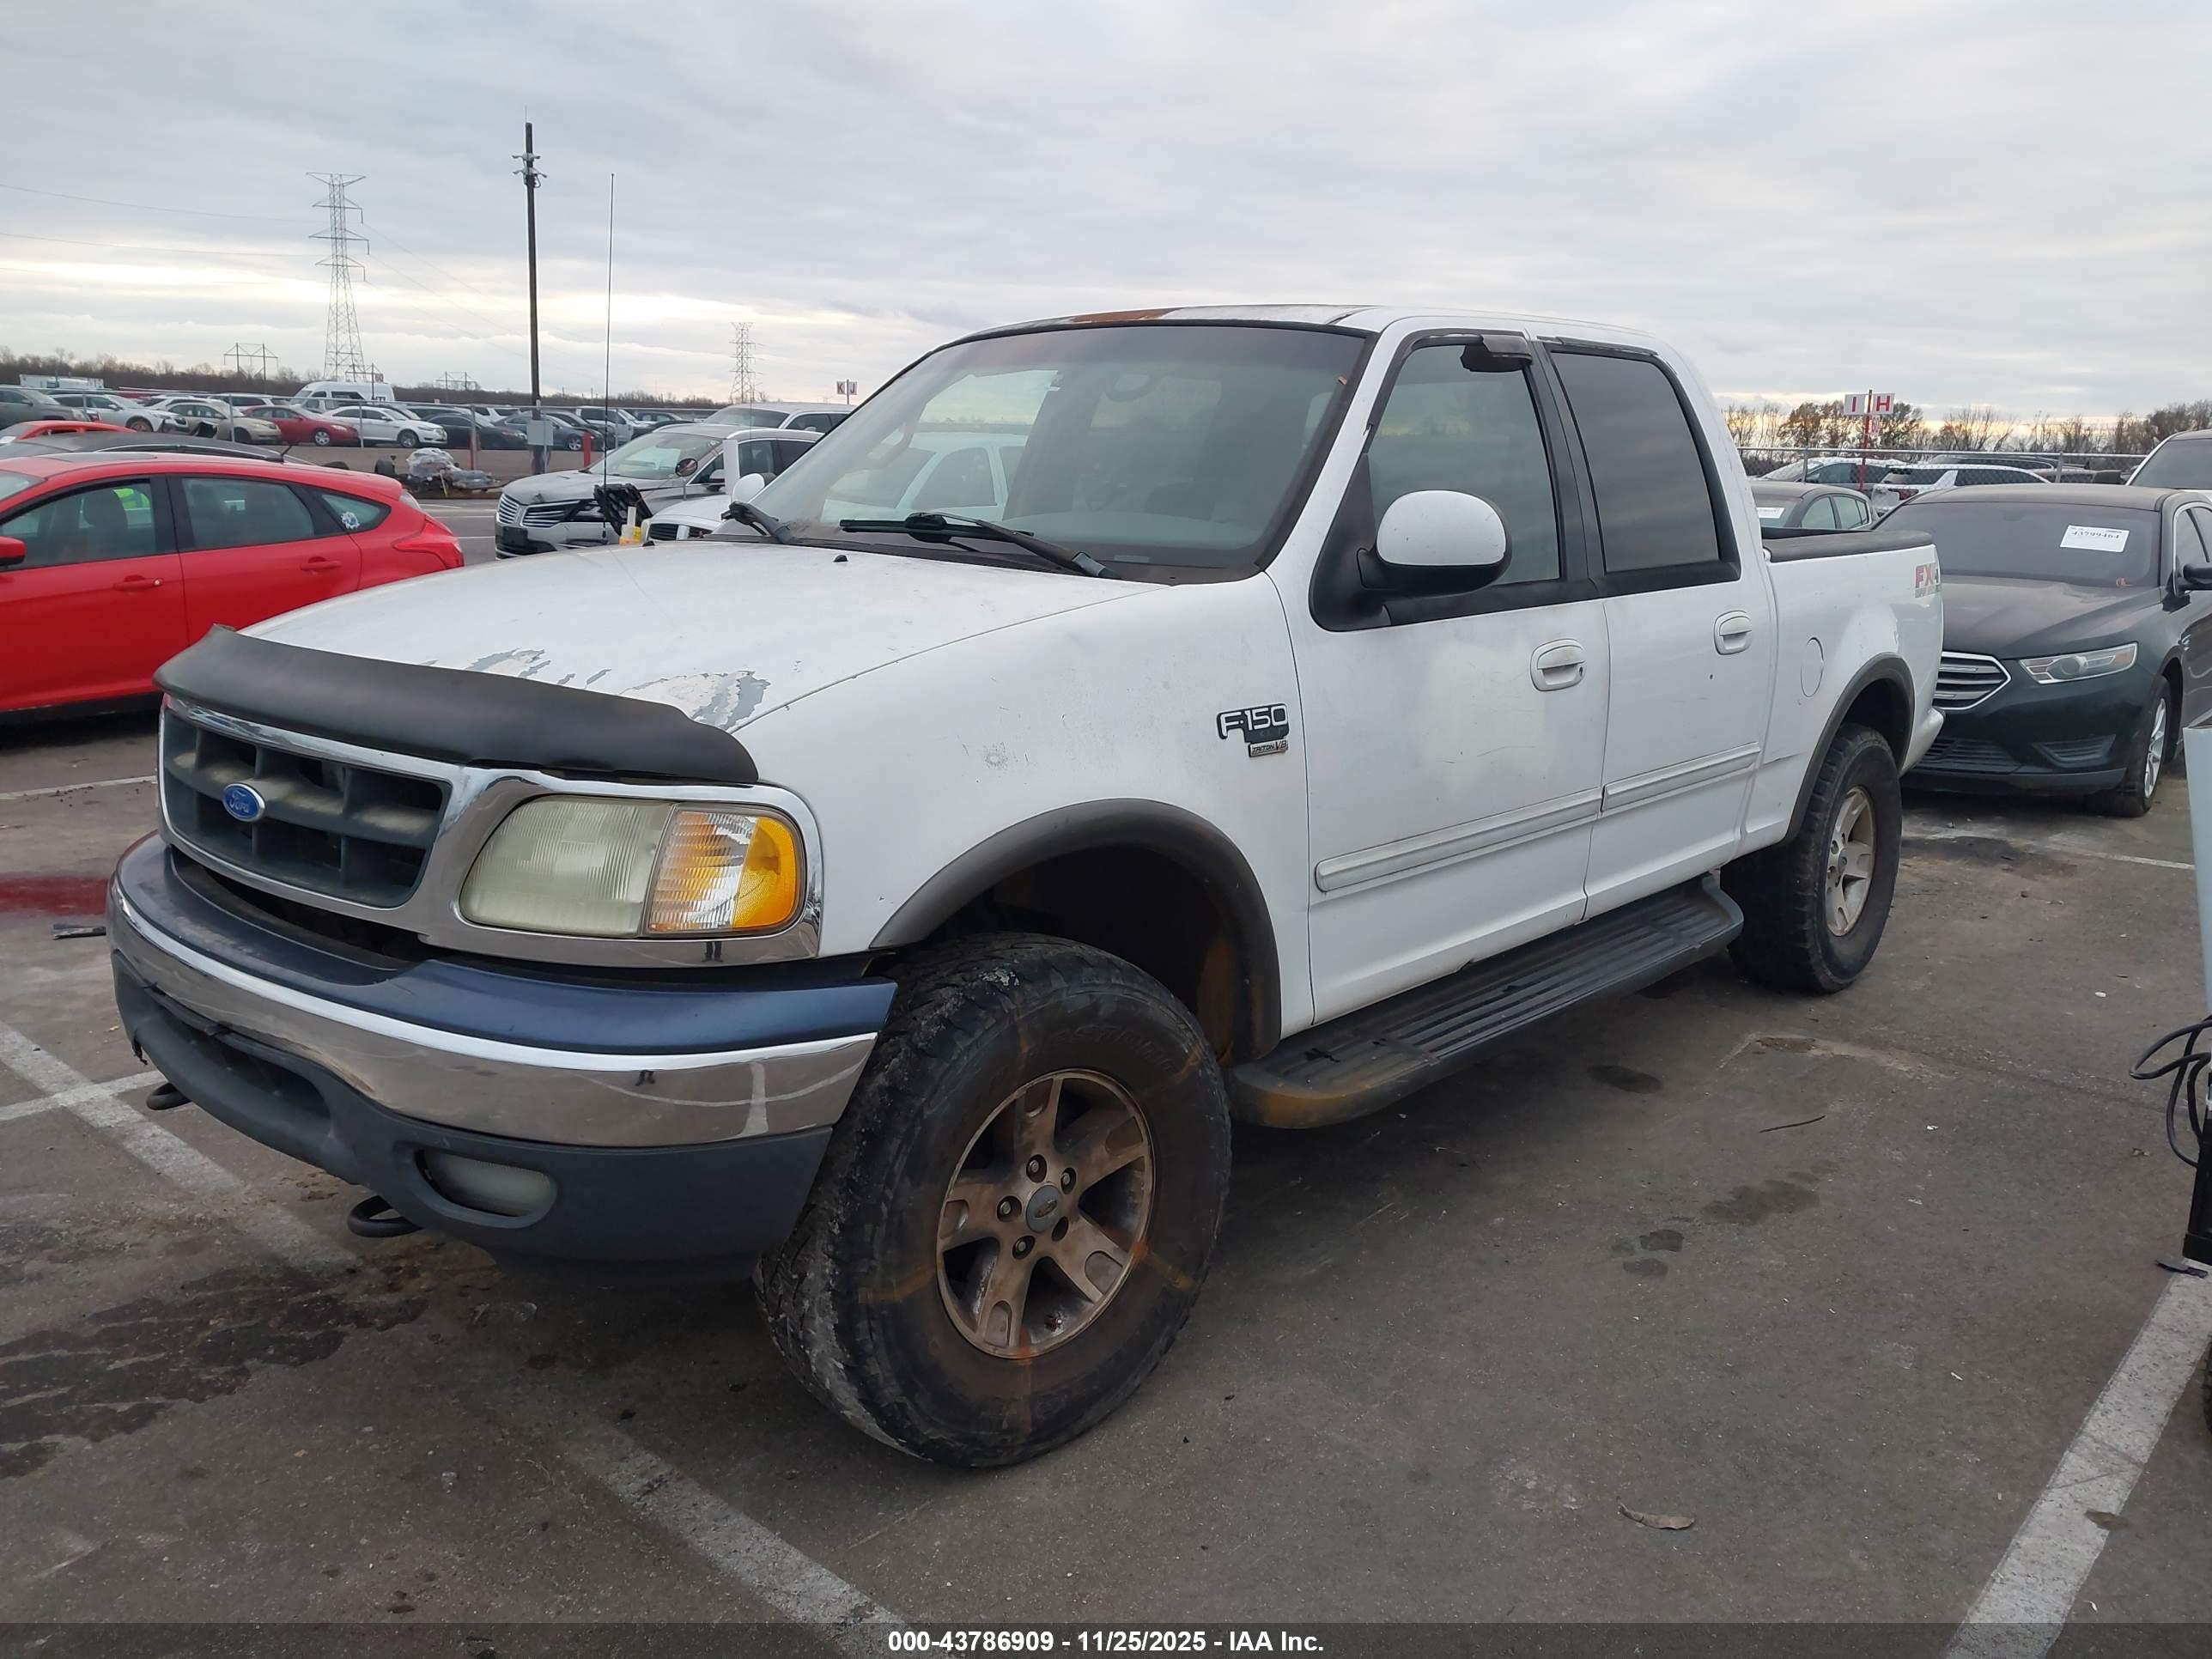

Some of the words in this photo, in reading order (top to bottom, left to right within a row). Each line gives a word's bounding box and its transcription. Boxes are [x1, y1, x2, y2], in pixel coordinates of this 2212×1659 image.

[837, 383, 844, 393] K
[850, 383, 855, 393] J
[1852, 397, 1857, 412] I
[1876, 396, 1891, 412] H
[1275, 739, 1287, 751] V8
[228, 789, 250, 814] Ford
